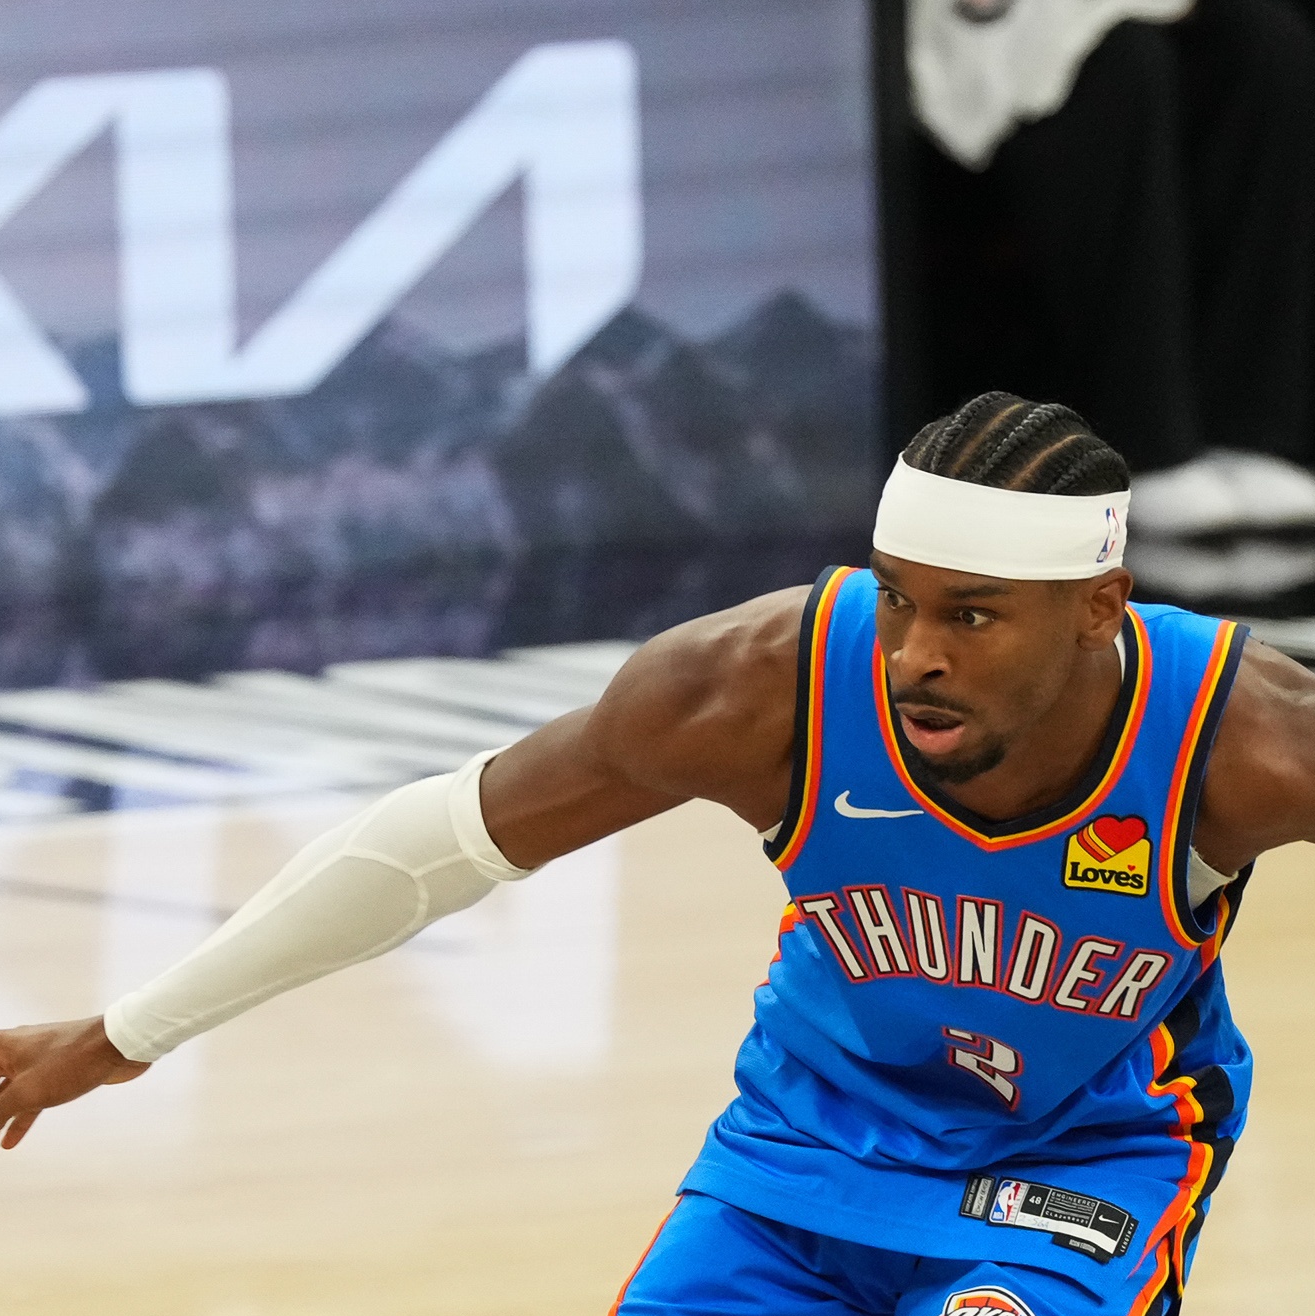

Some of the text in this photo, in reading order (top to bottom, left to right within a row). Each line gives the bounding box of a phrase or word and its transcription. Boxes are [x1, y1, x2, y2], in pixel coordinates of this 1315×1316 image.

[797, 885, 1172, 1021] THUNDER
[943, 1027, 1024, 1112] 2
[1028, 1195, 1042, 1205] 48
